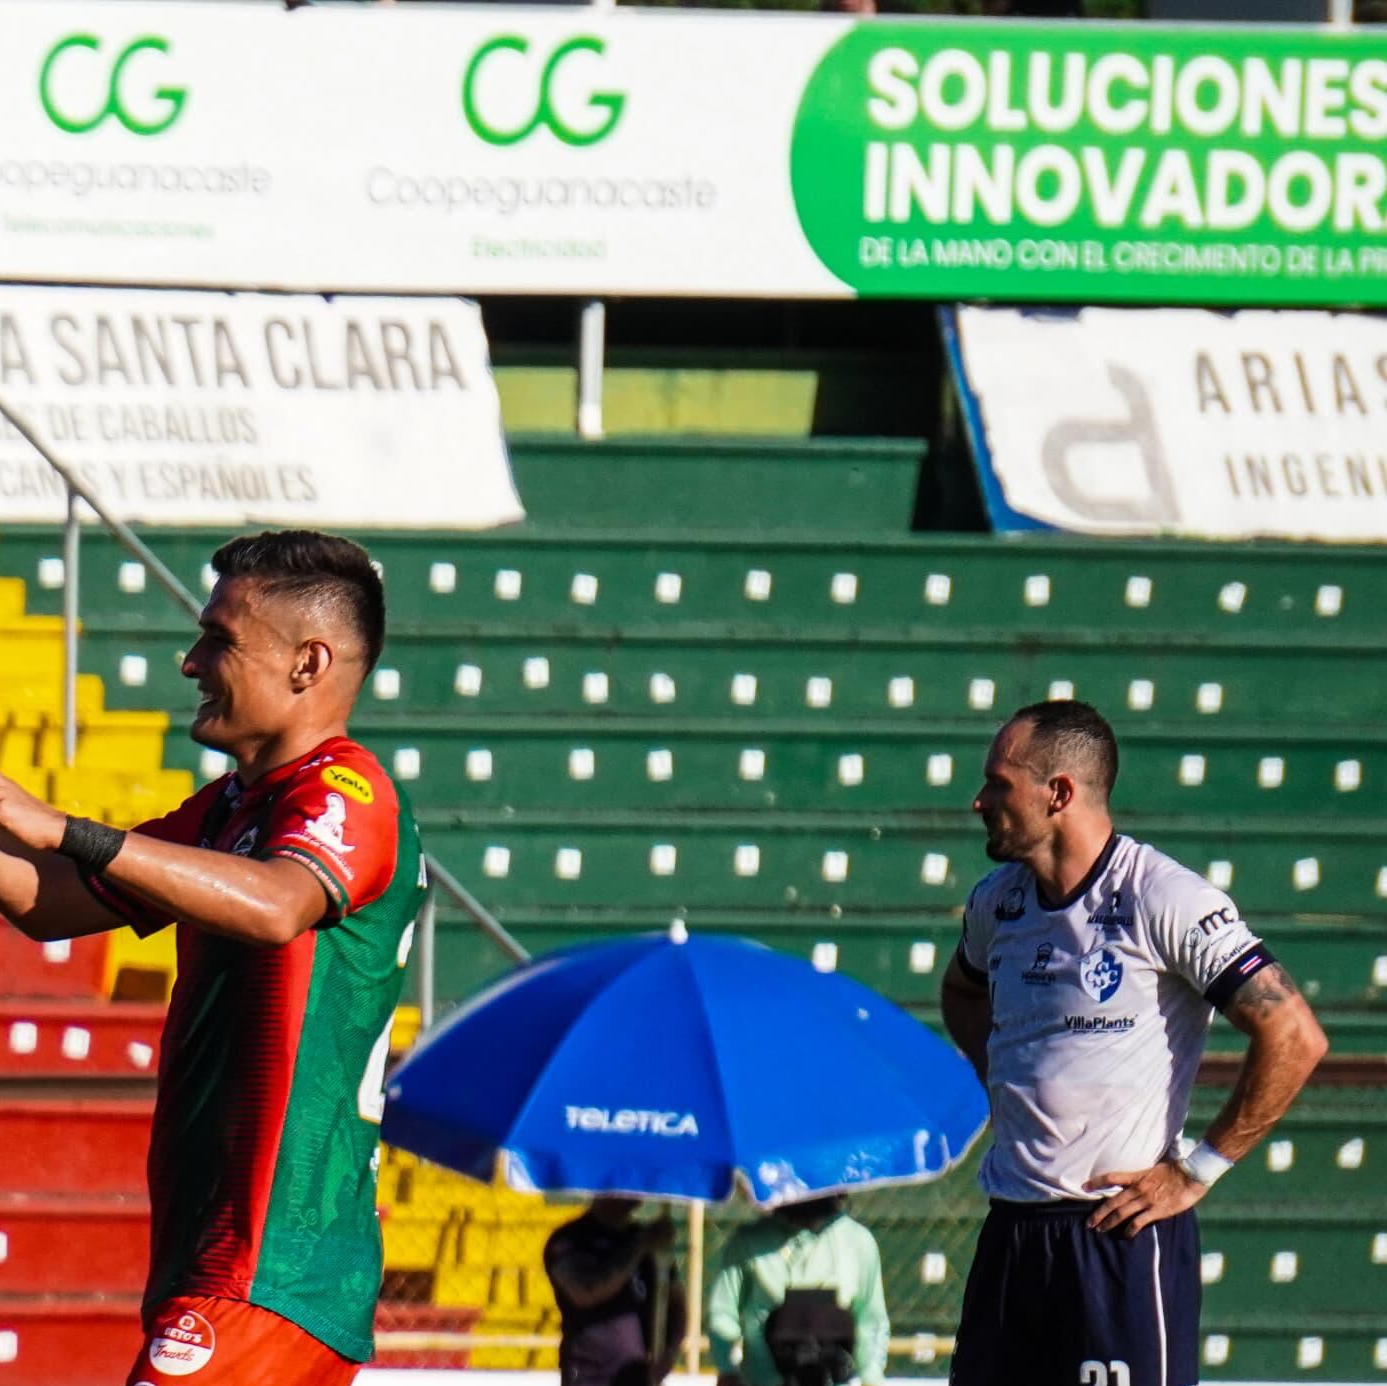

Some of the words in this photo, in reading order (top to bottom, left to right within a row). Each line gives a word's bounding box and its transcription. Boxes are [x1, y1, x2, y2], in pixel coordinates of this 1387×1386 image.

[38, 32, 188, 136] CG
[461, 32, 628, 148] CG
[865, 46, 1387, 140] SOLUCIONES
[367, 165, 719, 217] Coopeguanacaste
[861, 142, 1387, 233] INNOVADOR
[859, 236, 893, 267] DE
[898, 238, 928, 268] LA
[931, 238, 1012, 269] MANO
[1017, 239, 1078, 271] CON
[1081, 241, 1108, 272] EL
[1114, 241, 1282, 276] CRECIMIENTO
[1286, 245, 1319, 278] DE
[1324, 246, 1356, 278] LA
[49, 312, 253, 390] SANTA
[263, 316, 469, 392] CLARA
[46, 403, 89, 442] DE
[97, 403, 259, 444] CABALLOS
[110, 463, 129, 500] Y
[139, 455, 319, 503] ESPAÑOLES
